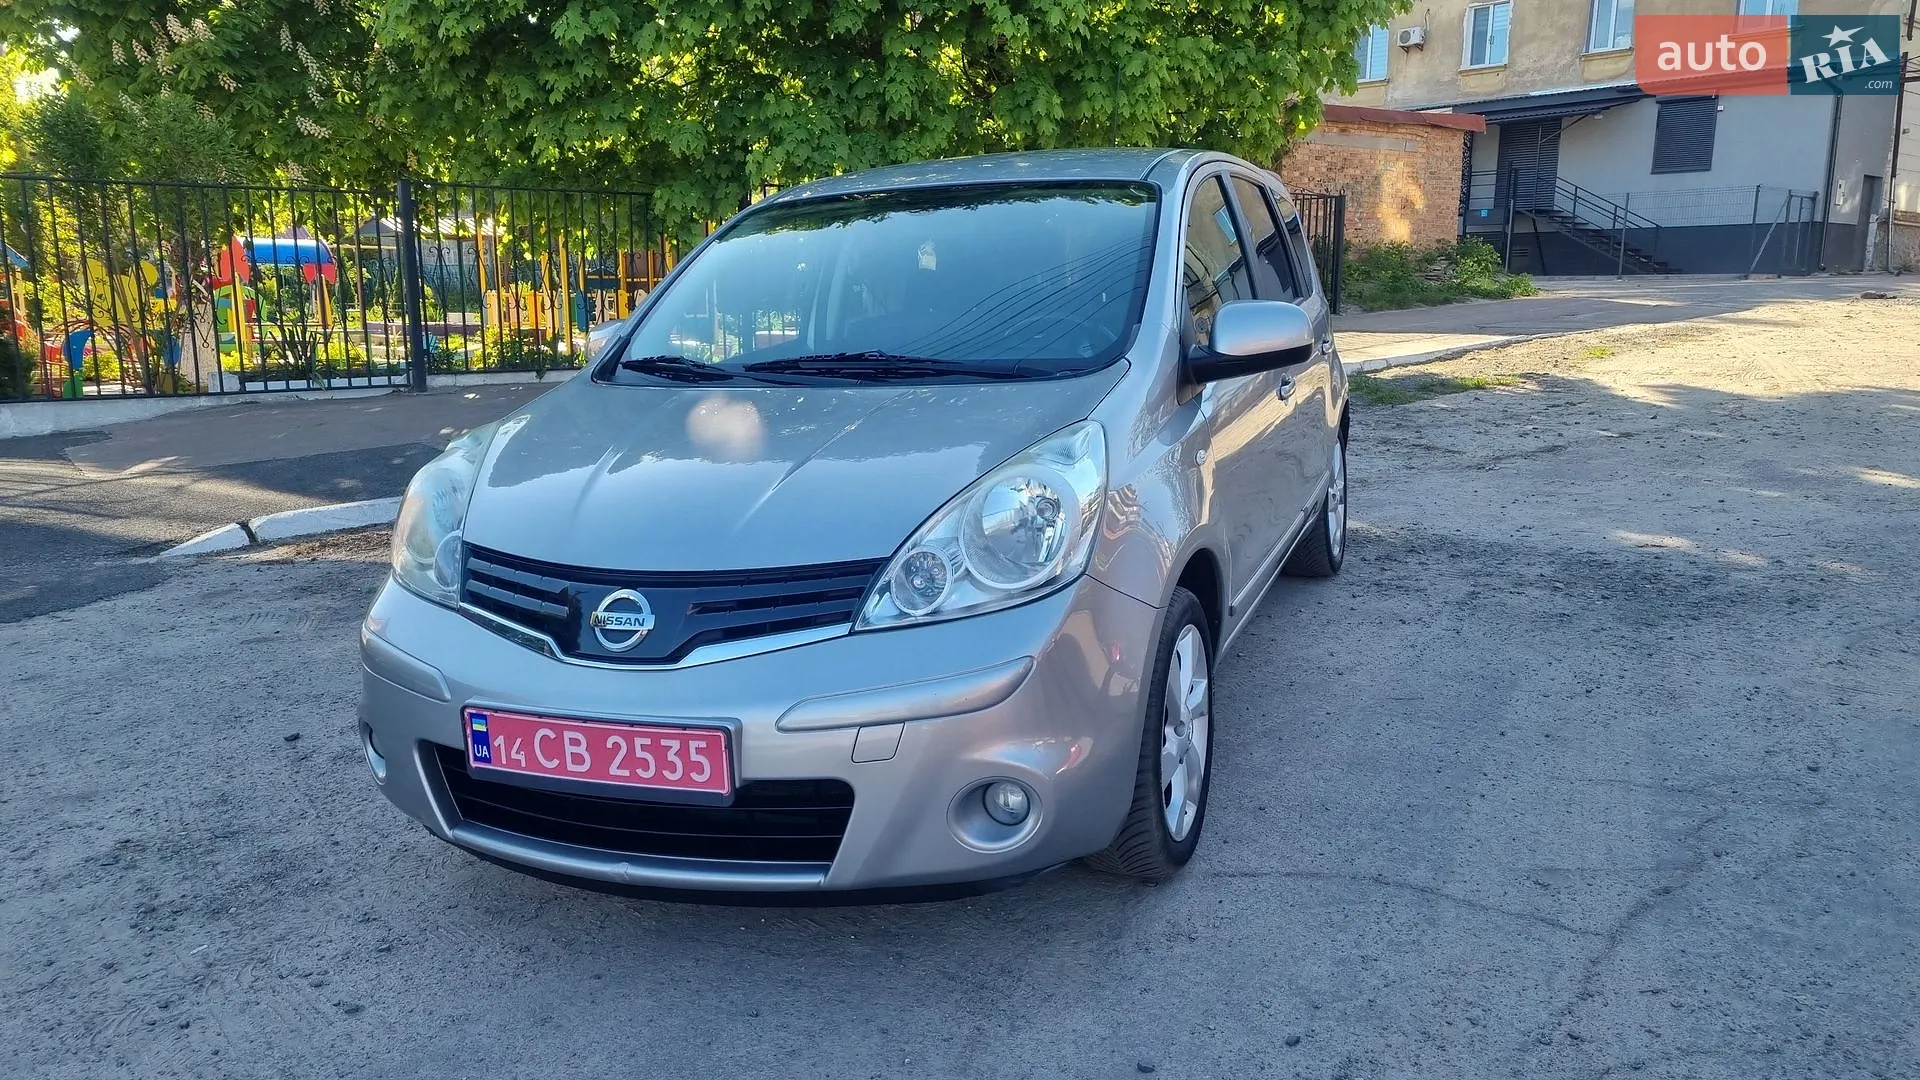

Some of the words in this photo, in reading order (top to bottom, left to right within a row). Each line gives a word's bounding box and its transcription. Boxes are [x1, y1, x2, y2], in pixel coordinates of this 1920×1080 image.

[593, 613, 645, 628] NISSAN
[474, 744, 490, 759] UA
[606, 735, 711, 783] 2535
